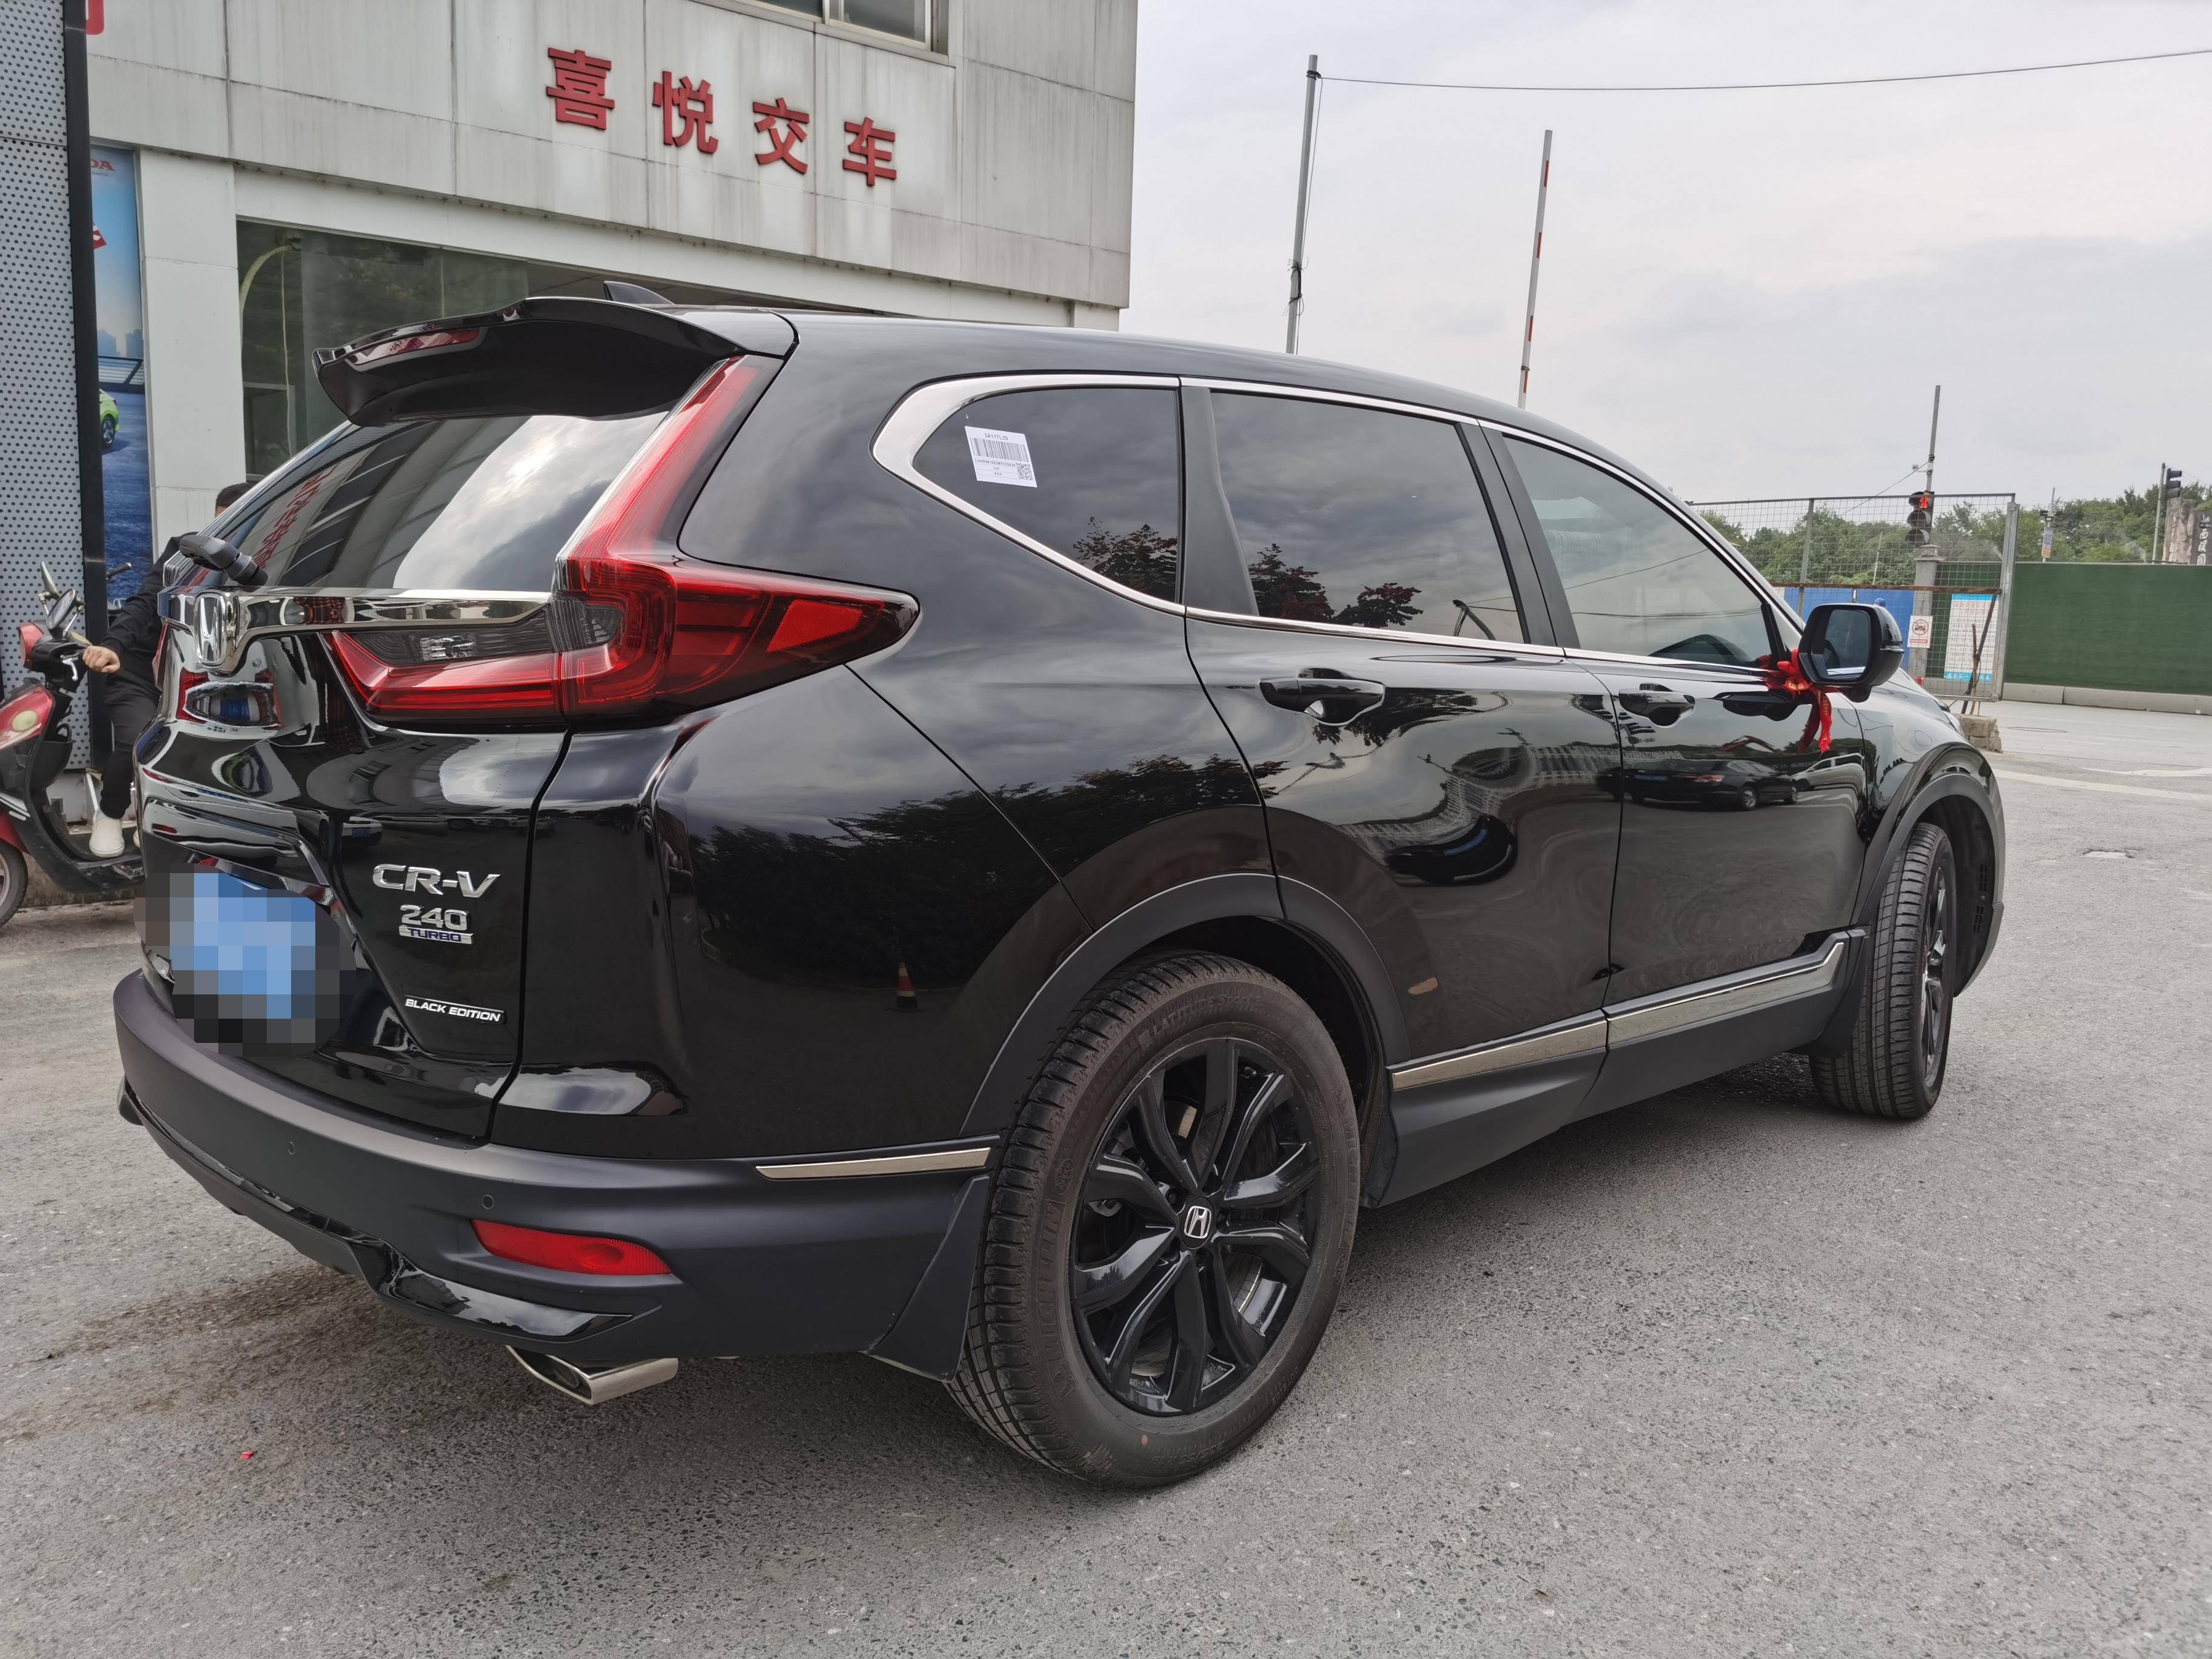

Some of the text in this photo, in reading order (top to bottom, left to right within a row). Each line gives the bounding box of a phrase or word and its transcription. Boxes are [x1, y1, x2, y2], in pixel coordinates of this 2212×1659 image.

[546, 47, 897, 187] 喜悦交车
[372, 863, 501, 898] CR-V
[400, 904, 469, 931] 240
[408, 927, 462, 942] TURBO
[405, 998, 501, 1022] BLACK EDITION
[1037, 1201, 1065, 1361] MICHELIN
